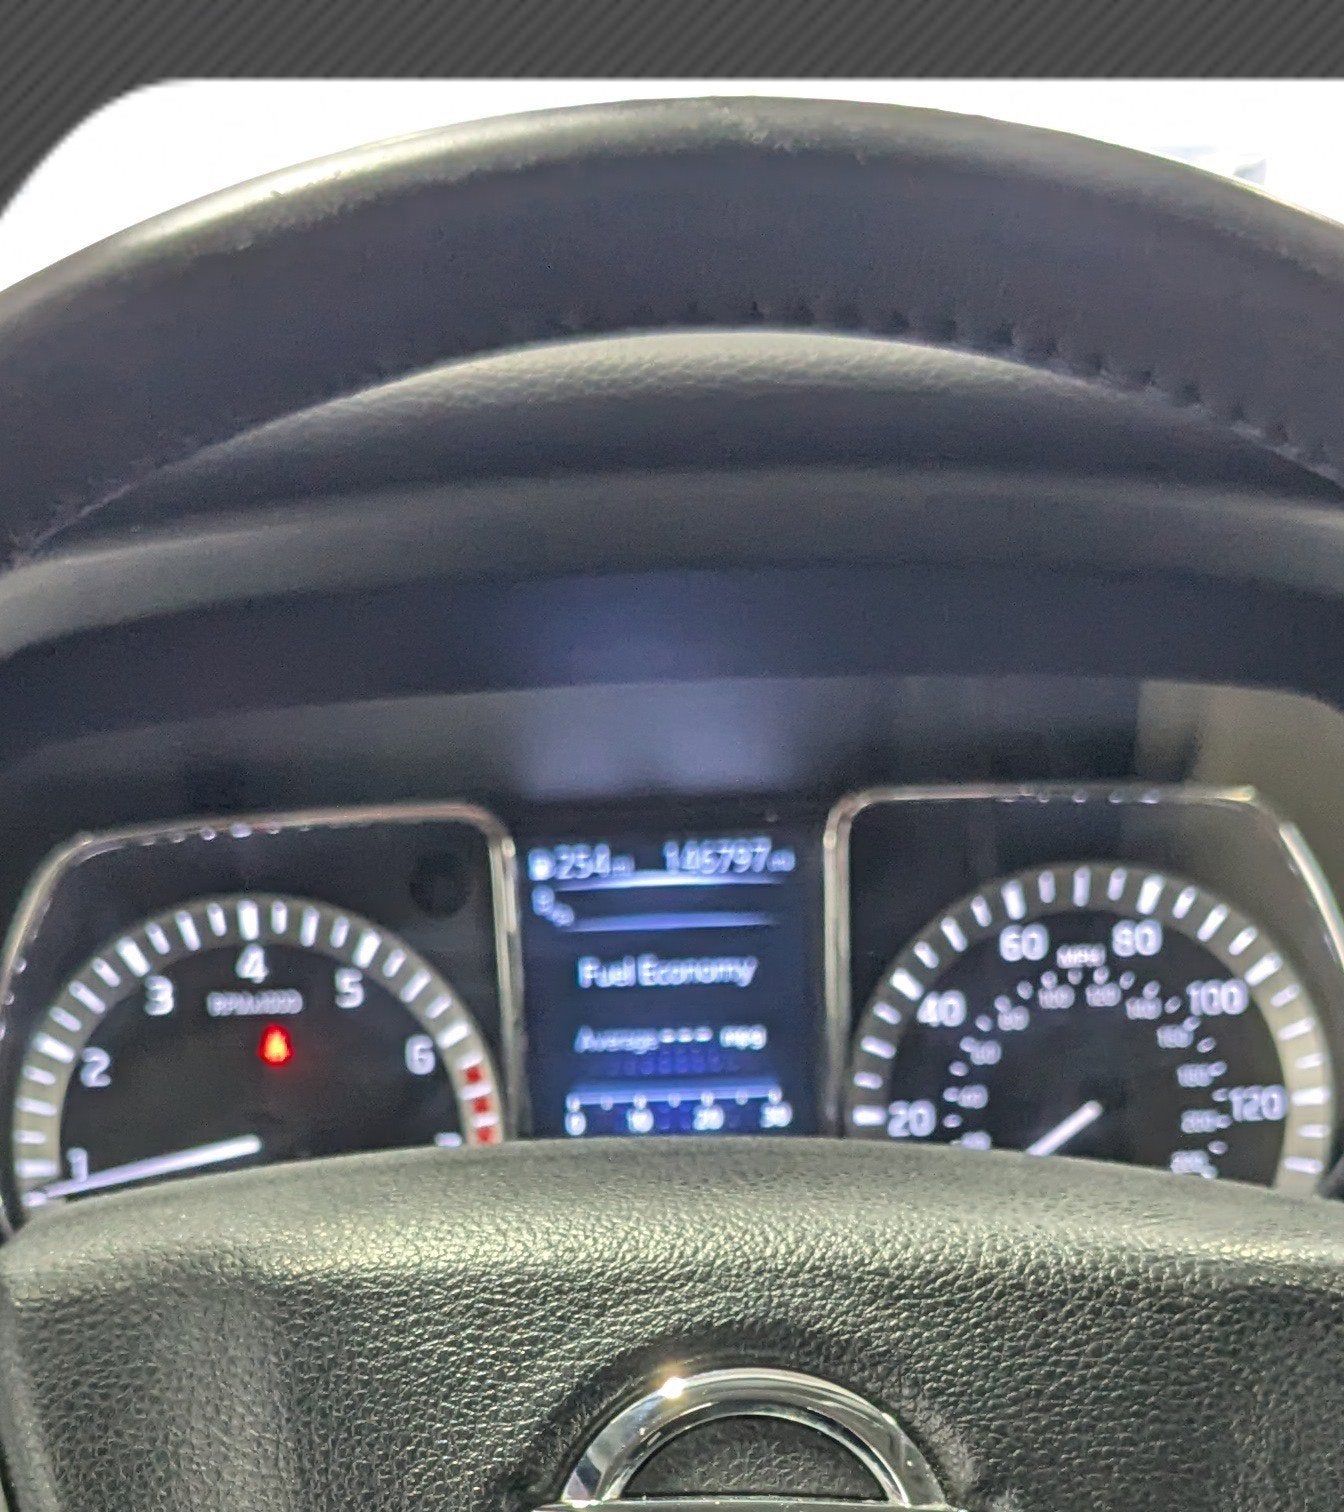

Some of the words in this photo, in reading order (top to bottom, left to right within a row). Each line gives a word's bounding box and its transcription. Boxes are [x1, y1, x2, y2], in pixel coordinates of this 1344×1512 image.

[999, 923, 1050, 962] 60
[1112, 919, 1163, 957] 80
[236, 943, 269, 984] 4
[577, 956, 635, 988] Fuel
[637, 954, 758, 988] Economy
[145, 975, 175, 1016] 3
[335, 967, 365, 1008] 5
[1186, 978, 1250, 1015] 100
[916, 989, 967, 1028] 40
[80, 1047, 111, 1088] 2
[404, 1034, 436, 1075] 6
[888, 1100, 937, 1138] 20
[1228, 1084, 1288, 1121] 120
[69, 1148, 88, 1182] 1
